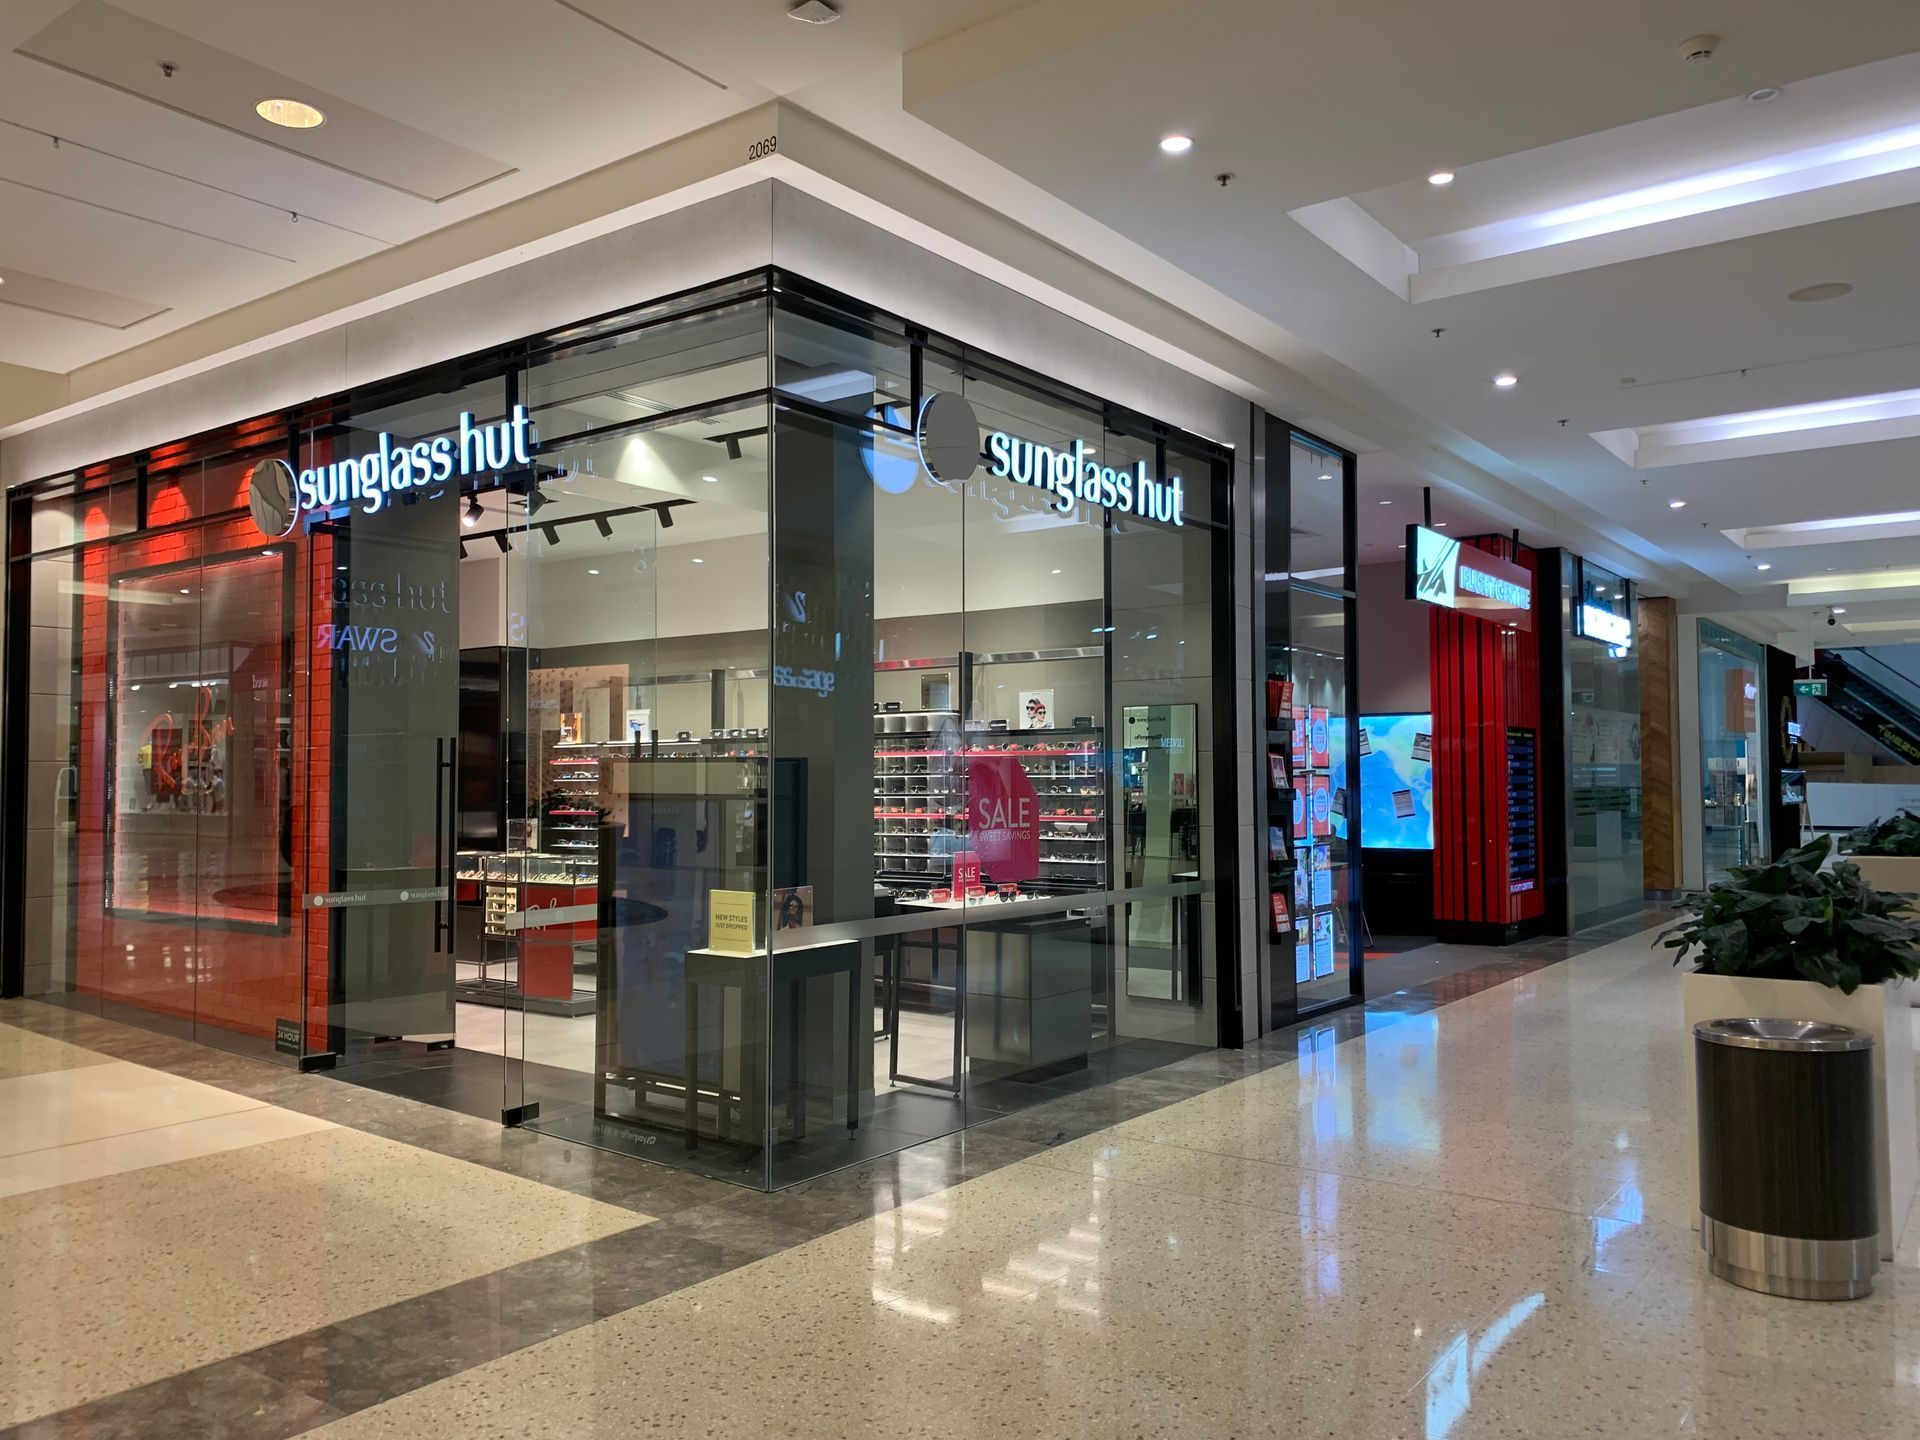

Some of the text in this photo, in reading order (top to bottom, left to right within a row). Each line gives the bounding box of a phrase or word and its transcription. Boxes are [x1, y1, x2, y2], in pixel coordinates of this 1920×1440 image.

[748, 135, 777, 160] 2069
[300, 404, 532, 514] sunglass hut
[988, 431, 1184, 527] sunglass hut
[978, 797, 1031, 830] SALE
[1002, 830, 1031, 841] SAVINGS
[958, 866, 976, 879] SALE
[354, 893, 367, 902] hut
[715, 913, 748, 923] NEW STYLES
[726, 922, 748, 931] DROPPED
